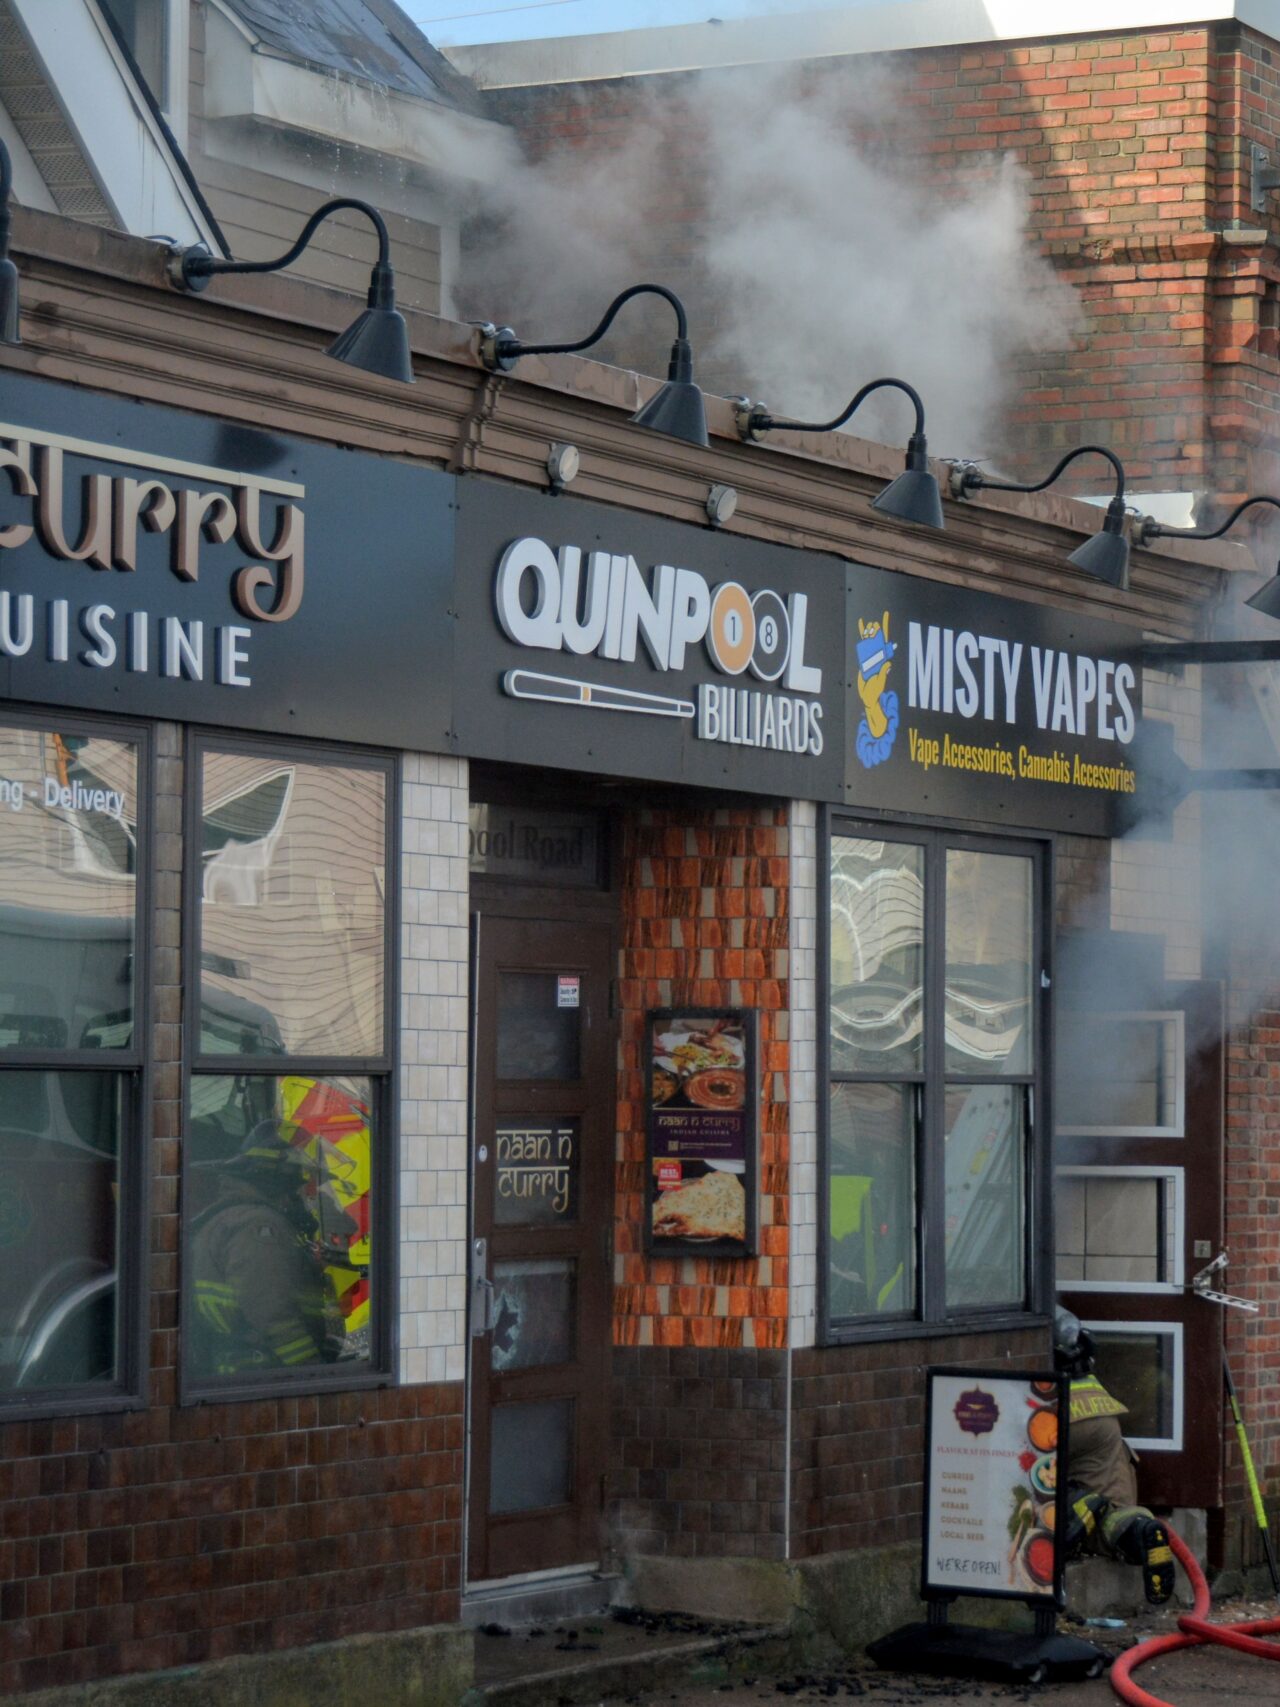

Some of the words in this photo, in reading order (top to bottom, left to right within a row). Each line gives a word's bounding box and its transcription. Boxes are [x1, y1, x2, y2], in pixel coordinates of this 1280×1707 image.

[498, 537, 822, 695] QUINPOOL
[908, 621, 1022, 725] MISTY
[1031, 646, 1135, 745] VAPES
[699, 683, 824, 757] BILLIARDS
[908, 727, 939, 771] Vape
[942, 733, 1016, 781] Accessories,
[1018, 744, 1070, 784] Cannabis
[1073, 753, 1136, 793] Accessories
[44, 777, 125, 822] Delivery
[496, 1130, 552, 1161] naan
[557, 1129, 573, 1160] n
[498, 1166, 570, 1213] curry
